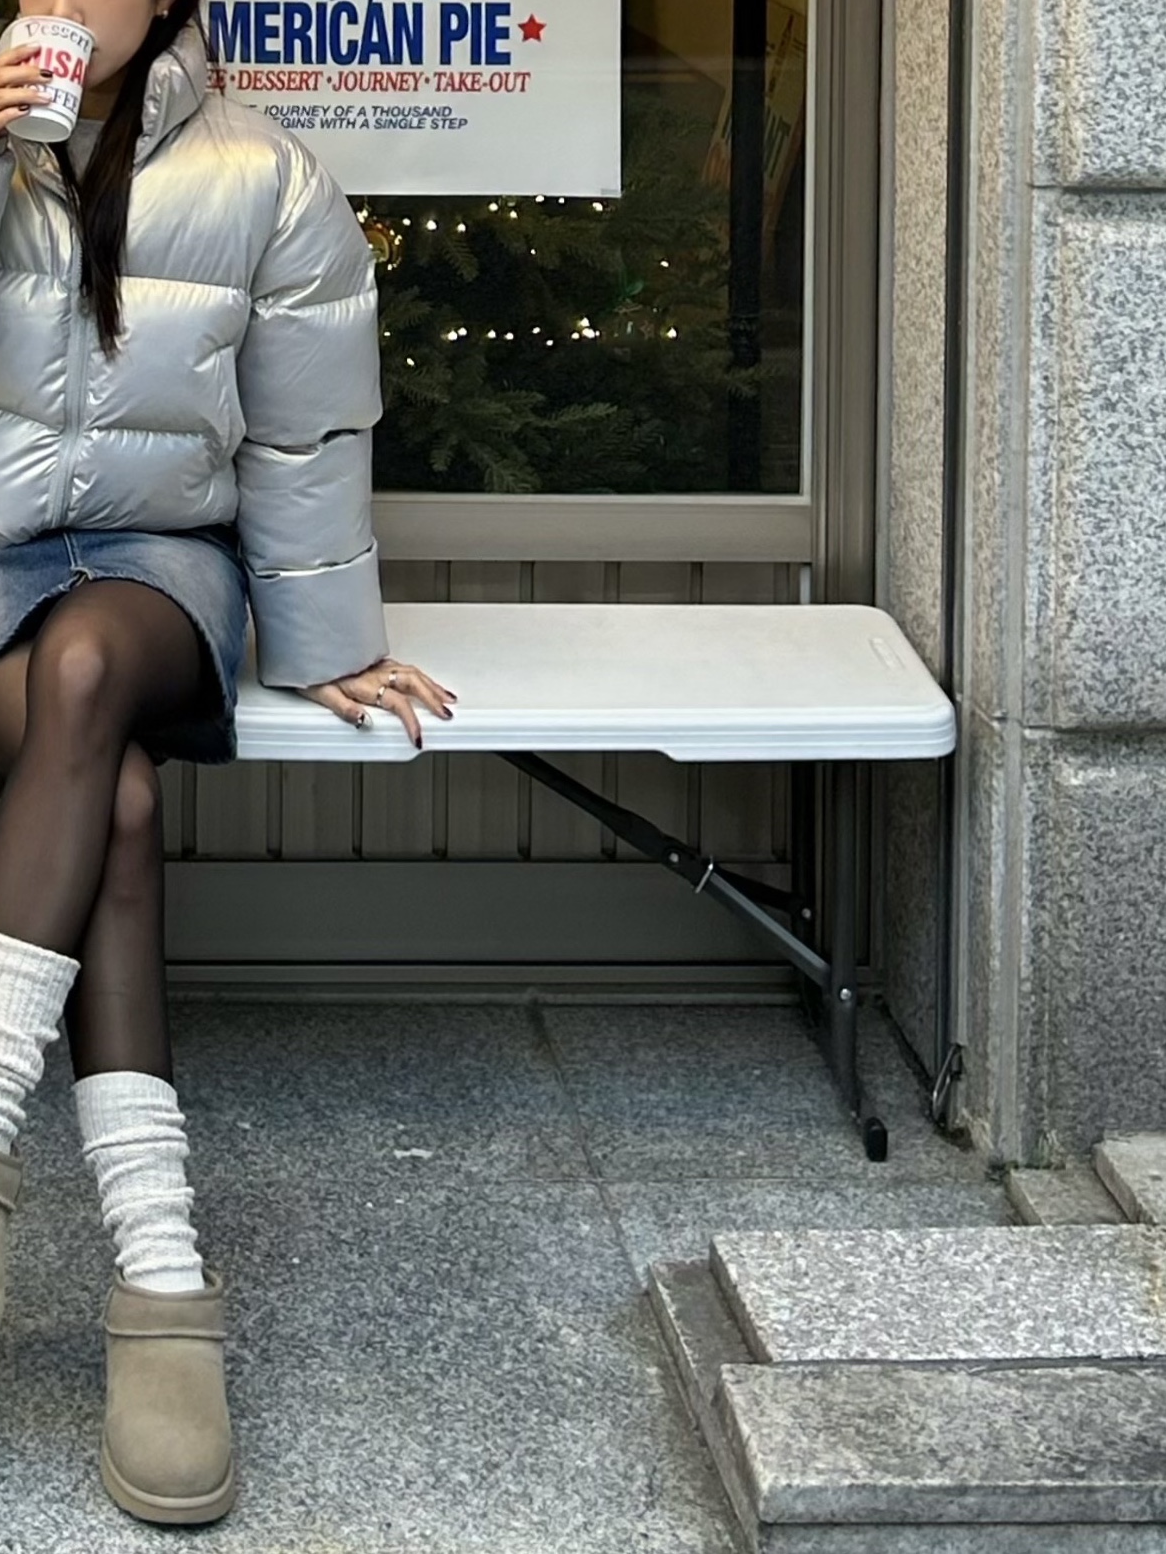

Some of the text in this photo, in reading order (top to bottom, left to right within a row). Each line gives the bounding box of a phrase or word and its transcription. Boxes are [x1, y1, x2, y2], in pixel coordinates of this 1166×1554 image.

[207, 1, 512, 66] MERICAN PIE
[236, 70, 323, 93] DESSERT
[331, 71, 424, 93] JOURNEY
[434, 71, 531, 94] TAKE-OUT
[264, 105, 329, 118] JOURNEY
[333, 105, 353, 118] OF
[356, 106, 366, 118] A
[371, 106, 452, 118] THOUSAND
[319, 118, 357, 130] WITH
[360, 119, 370, 130] A
[373, 118, 426, 130] SINGLE
[429, 119, 468, 130] STEP
